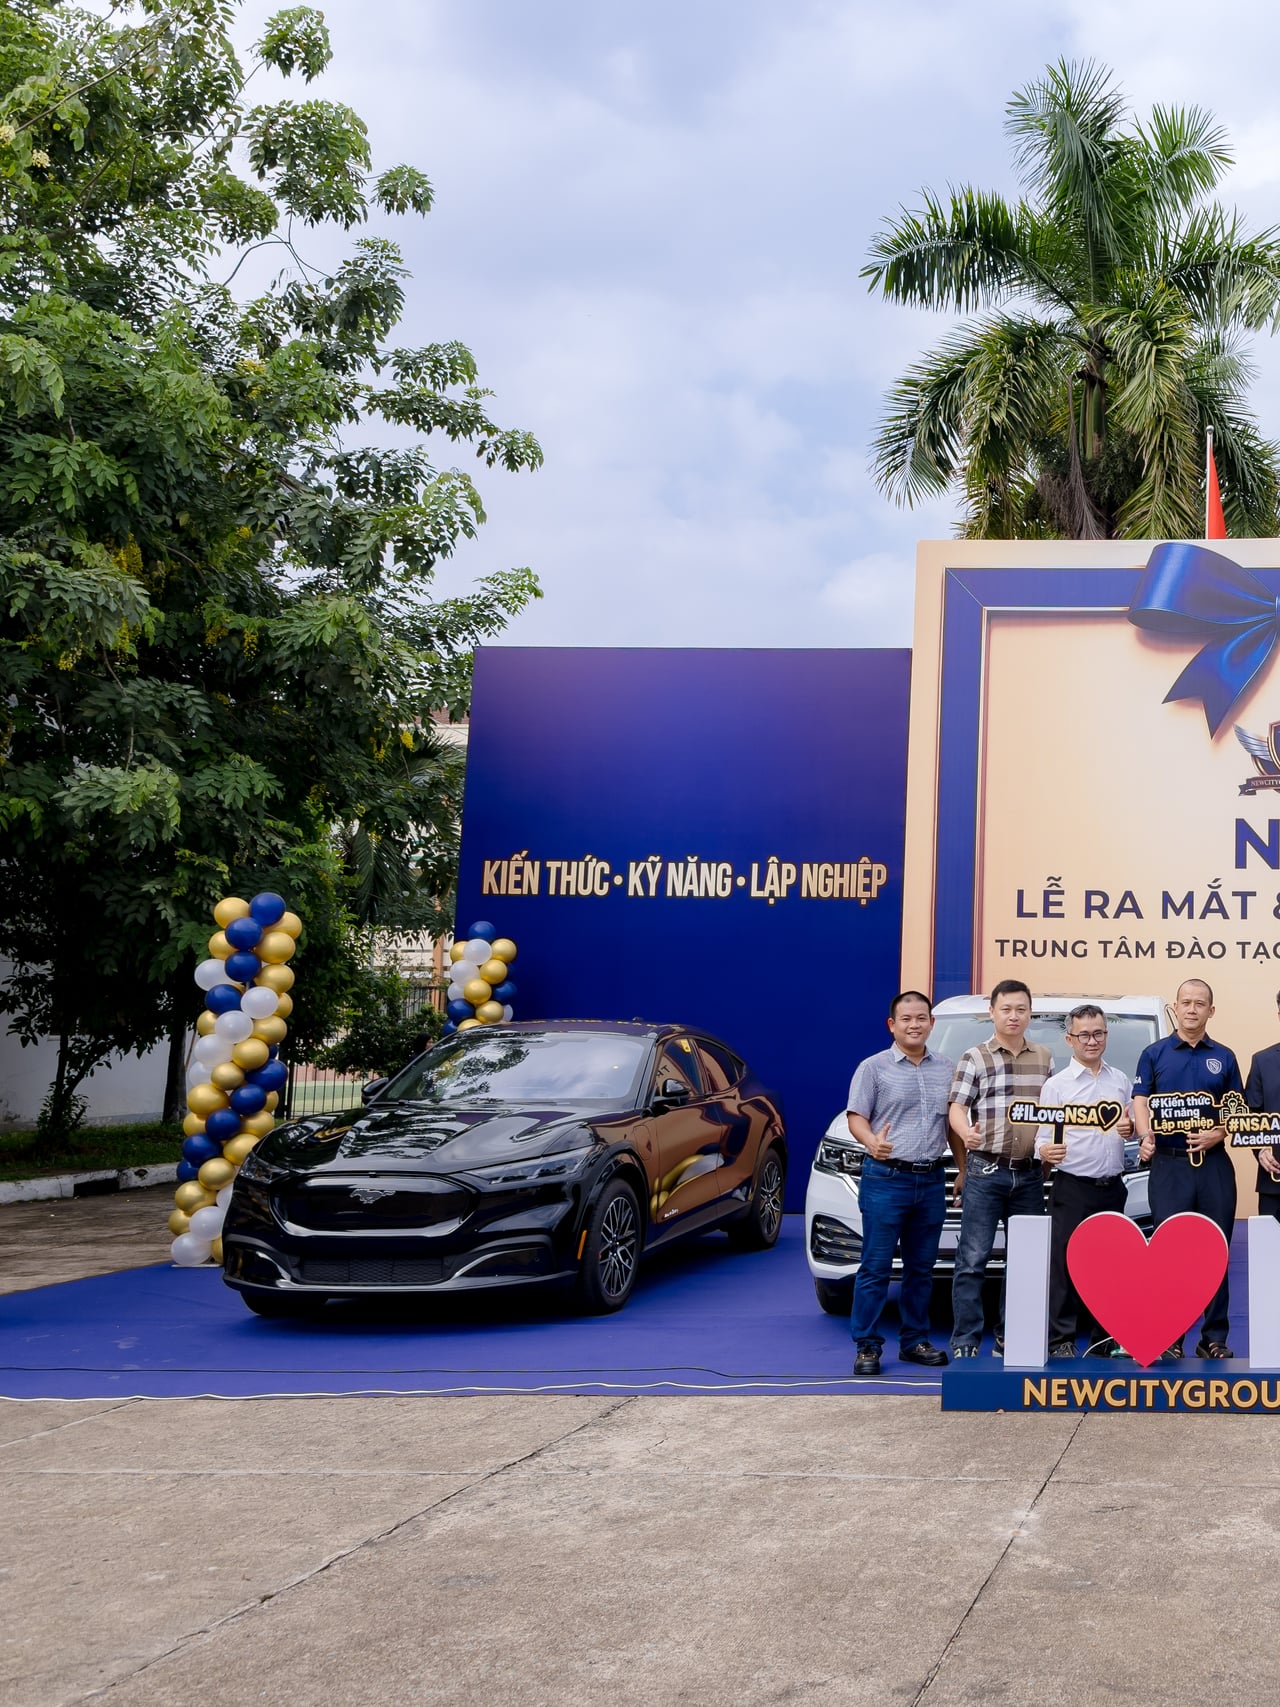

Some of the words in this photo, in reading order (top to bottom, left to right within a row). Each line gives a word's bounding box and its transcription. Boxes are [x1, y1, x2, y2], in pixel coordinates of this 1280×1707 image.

[482, 850, 540, 896] KIẾN
[545, 854, 611, 897] THỨC
[627, 856, 663, 898] KỸ
[666, 856, 733, 898] NĂNG
[750, 857, 797, 905] LẬP
[801, 857, 888, 905] NGHIỆP
[1016, 876, 1065, 919] LỄ
[1084, 890, 1144, 919] RA
[1161, 878, 1257, 920] MẮT
[995, 938, 1088, 958] TRUNG
[1098, 936, 1156, 959] TÂM
[1165, 936, 1227, 960] ĐÀO
[1151, 1096, 1185, 1108] #Kiến
[1187, 1095, 1210, 1106] thức
[1011, 1104, 1098, 1124] #ILoveNSA
[1154, 1119, 1175, 1132] Lập
[1177, 1117, 1214, 1130] nghiệp
[1174, 1109, 1200, 1120] năng
[1004, 1214, 1052, 1368] I
